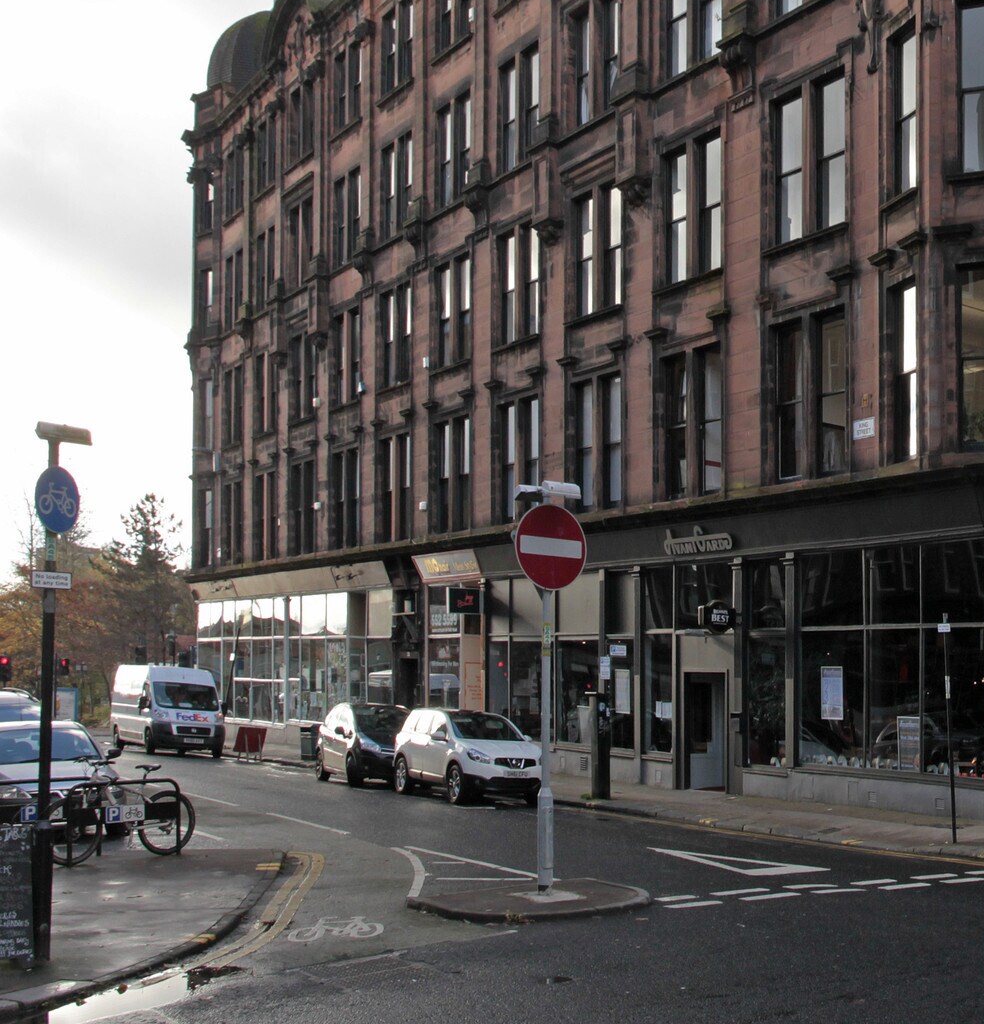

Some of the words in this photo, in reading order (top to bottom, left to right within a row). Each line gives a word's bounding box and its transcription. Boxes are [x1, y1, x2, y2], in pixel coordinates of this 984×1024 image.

[856, 428, 872, 436] STREET
[45, 574, 68, 582] loading
[711, 614, 730, 623] BEST
[176, 712, 209, 723] FedEx
[24, 806, 36, 821] P
[108, 807, 120, 821] P
